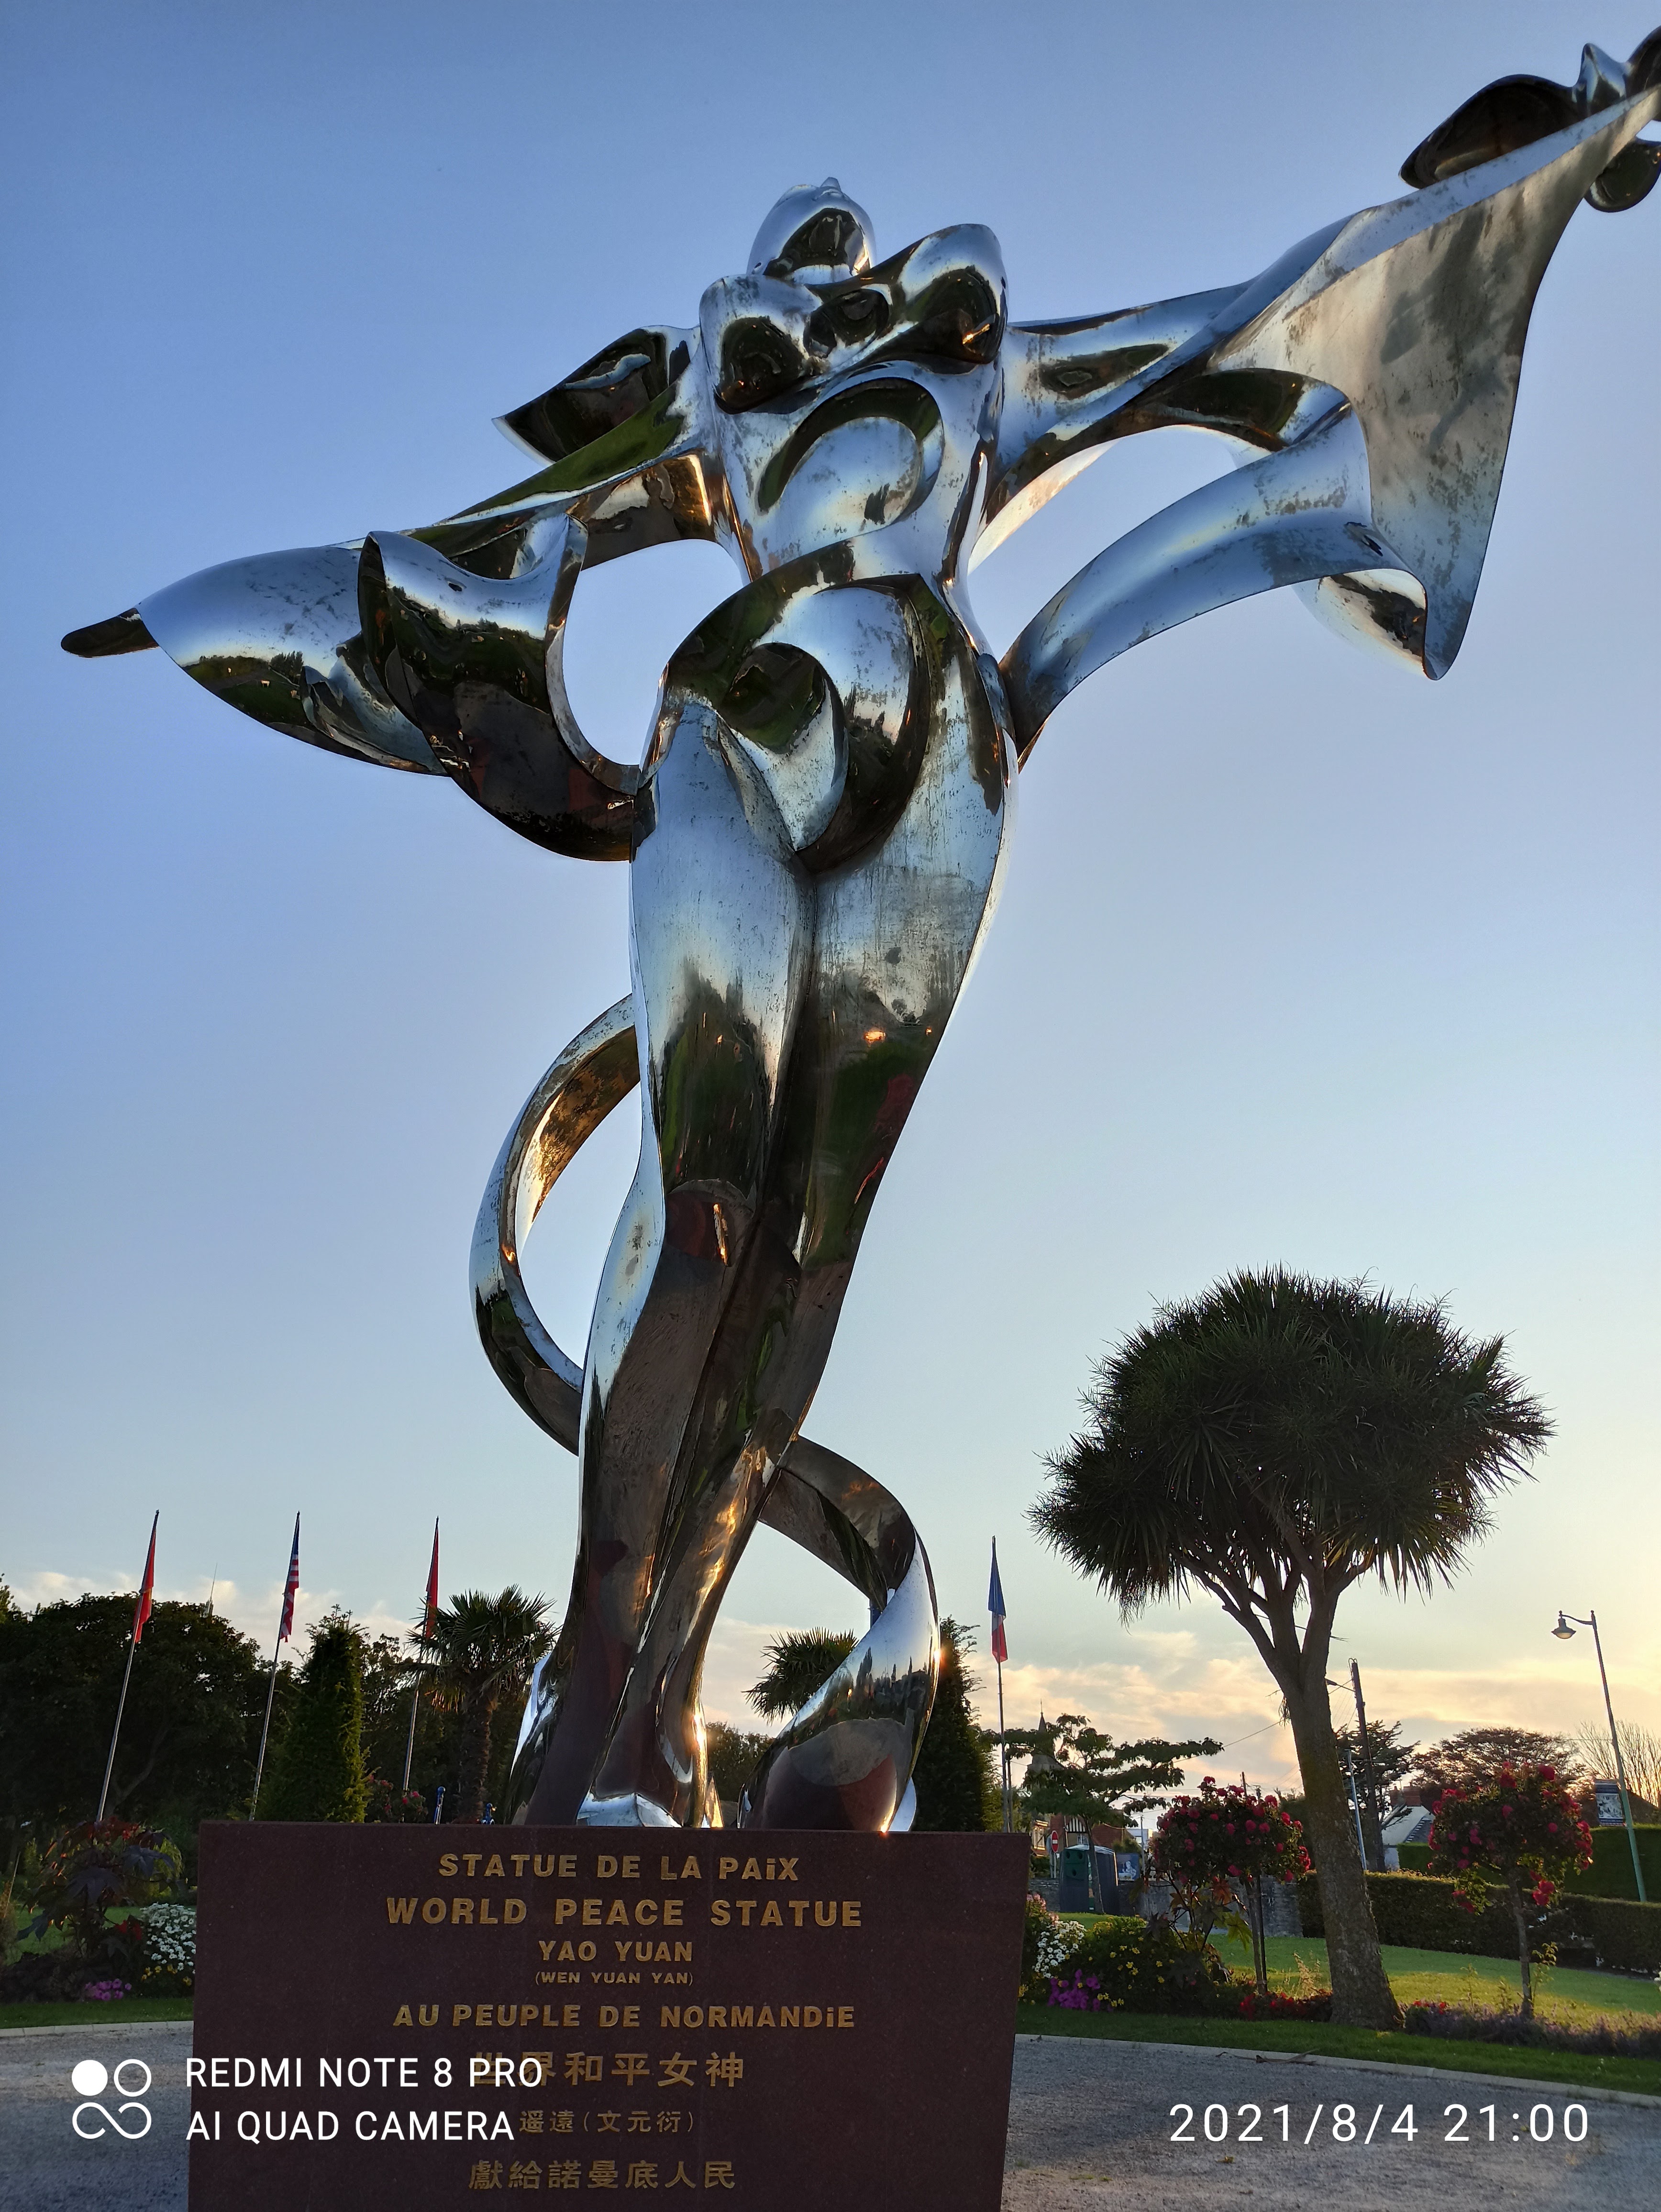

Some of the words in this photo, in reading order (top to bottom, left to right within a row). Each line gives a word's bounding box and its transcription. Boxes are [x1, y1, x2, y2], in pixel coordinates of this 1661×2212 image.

[438, 1853, 576, 1878] STATUE
[597, 1855, 641, 1879] DE
[660, 1855, 702, 1880] LA
[386, 1897, 527, 1925] WORLD
[554, 1898, 684, 1926] PEACE
[710, 1899, 862, 1927] STATUE
[538, 1940, 597, 1962] YAO
[614, 1941, 693, 1962] YUAN
[535, 1970, 580, 1986] (WEN
[591, 1972, 641, 1984] YUAN
[651, 1971, 693, 1986] YAN)
[392, 2004, 440, 2026] AU
[452, 2004, 581, 2027] PEUPLE
[598, 2005, 641, 2027] DE
[468, 2159, 735, 2190] 獻給諾曼底人民
